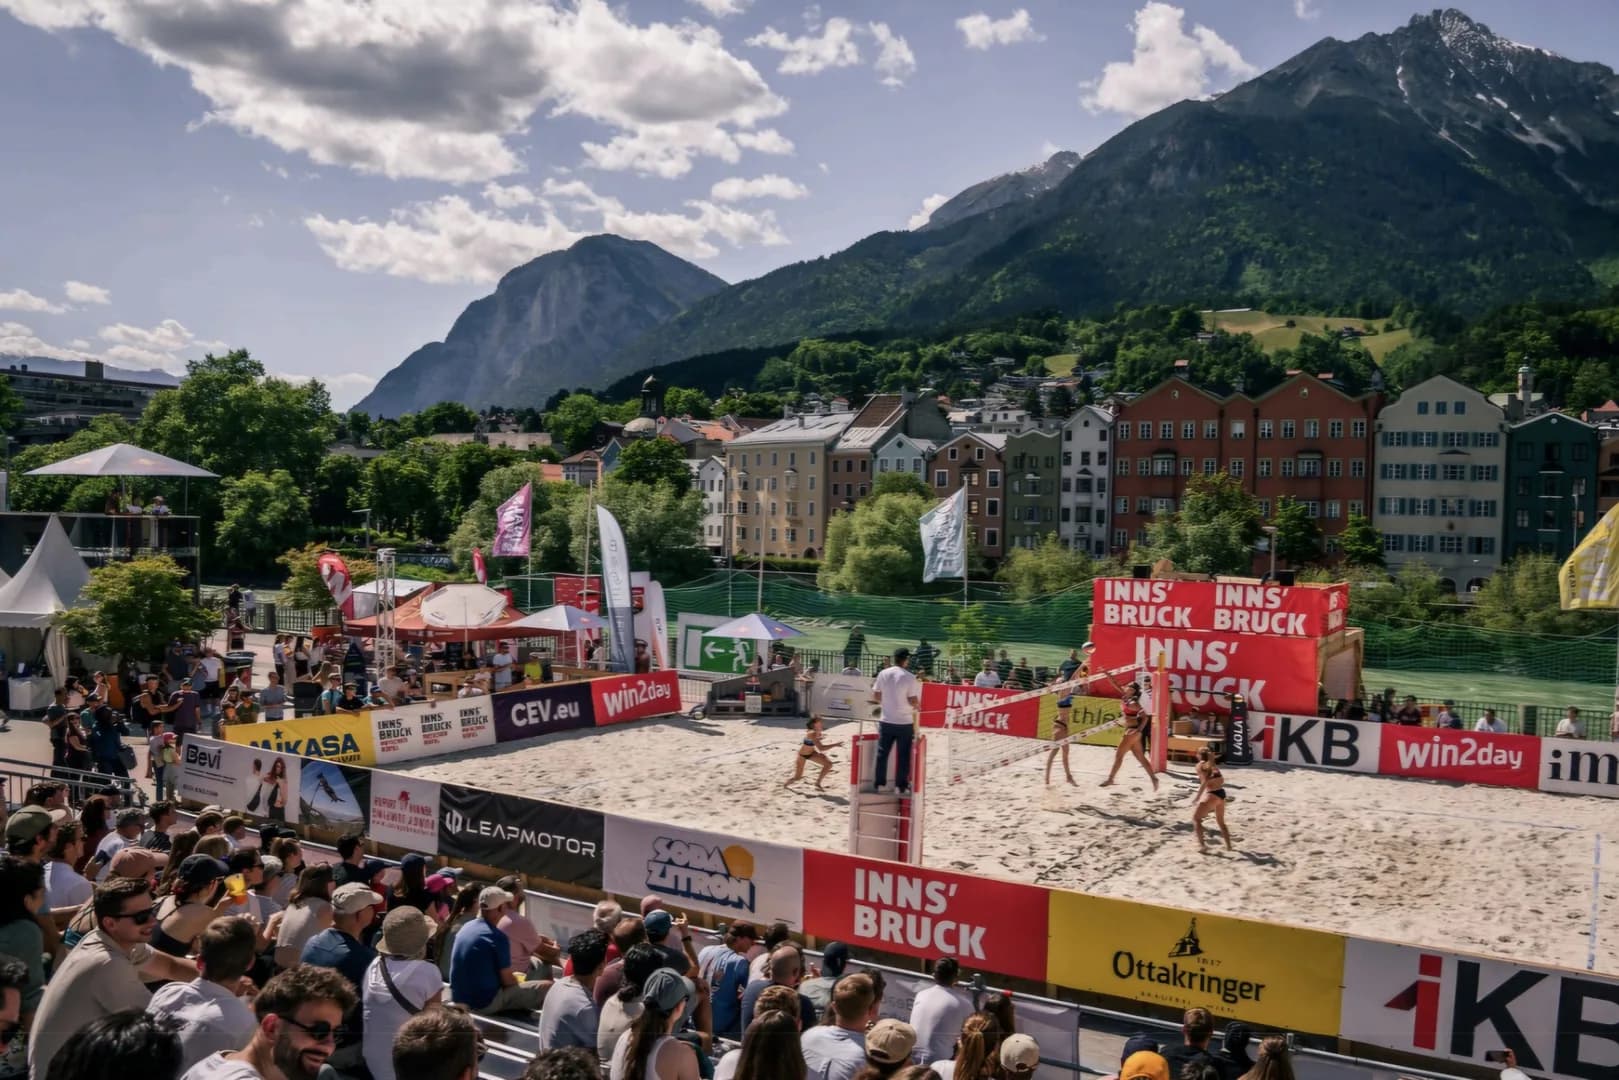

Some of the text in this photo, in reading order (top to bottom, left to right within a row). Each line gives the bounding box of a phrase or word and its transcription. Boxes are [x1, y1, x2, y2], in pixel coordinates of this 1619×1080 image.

[1105, 581, 1173, 603] INNS'
[1215, 584, 1288, 609] INNS'
[1104, 604, 1192, 628] BRUCK
[1214, 609, 1307, 636] BRUCK
[1136, 636, 1239, 672] INNS'
[511, 700, 580, 727] CEV.eu
[603, 680, 671, 717] win2day
[379, 727, 412, 740] BRUCK
[186, 744, 222, 770] Bevi
[1397, 736, 1522, 770] win2day
[466, 820, 595, 858] LEAPMOTOR
[653, 836, 730, 876] SODA
[645, 860, 756, 914] ZITRON
[855, 868, 958, 915] INNS'
[854, 904, 986, 960] BRUCK
[1113, 950, 1266, 1004] Ottakringer
